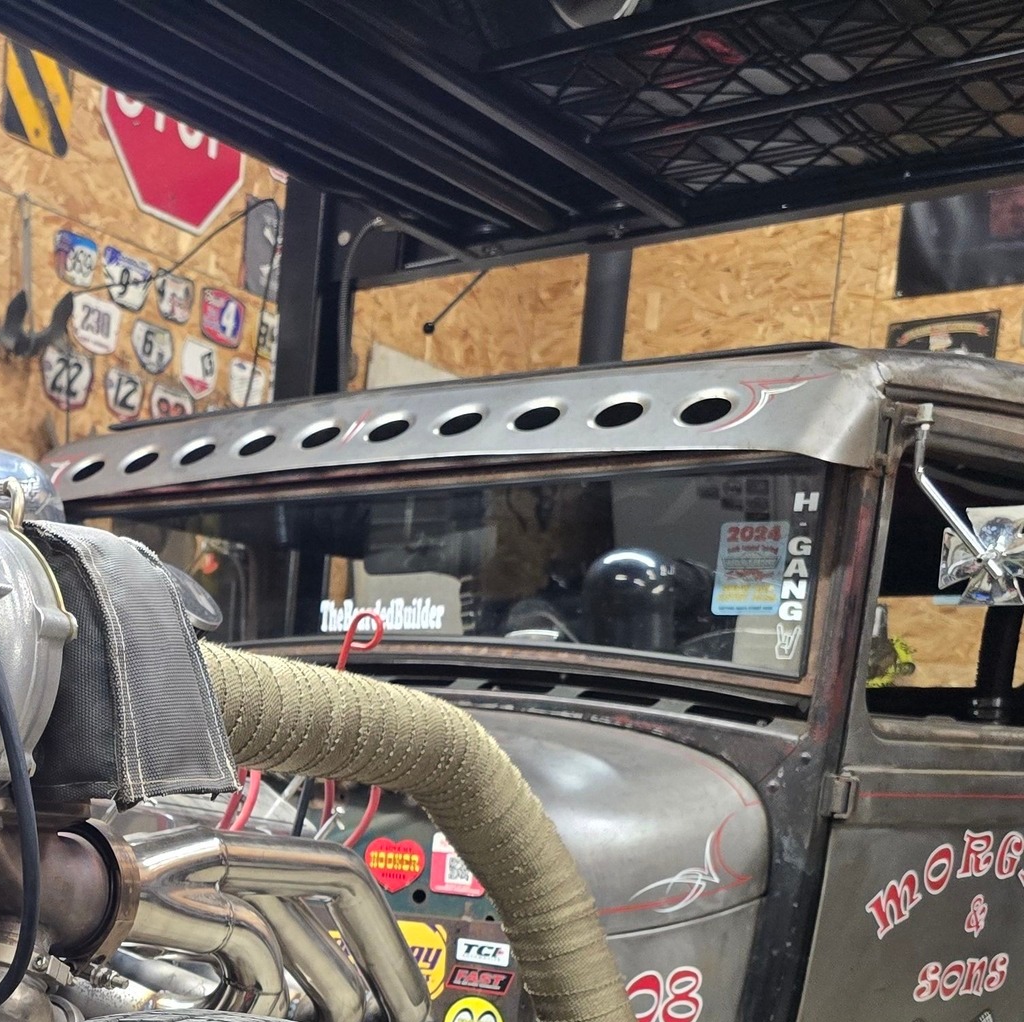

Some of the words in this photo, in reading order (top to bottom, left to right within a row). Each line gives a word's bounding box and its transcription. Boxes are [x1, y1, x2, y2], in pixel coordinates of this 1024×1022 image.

[51, 357, 83, 398] 22
[113, 375, 140, 411] 12
[727, 525, 782, 544] 2024
[369, 850, 420, 873] HOOKER
[866, 828, 1024, 940] MORG
[964, 893, 988, 938] &
[453, 968, 507, 989] FAST
